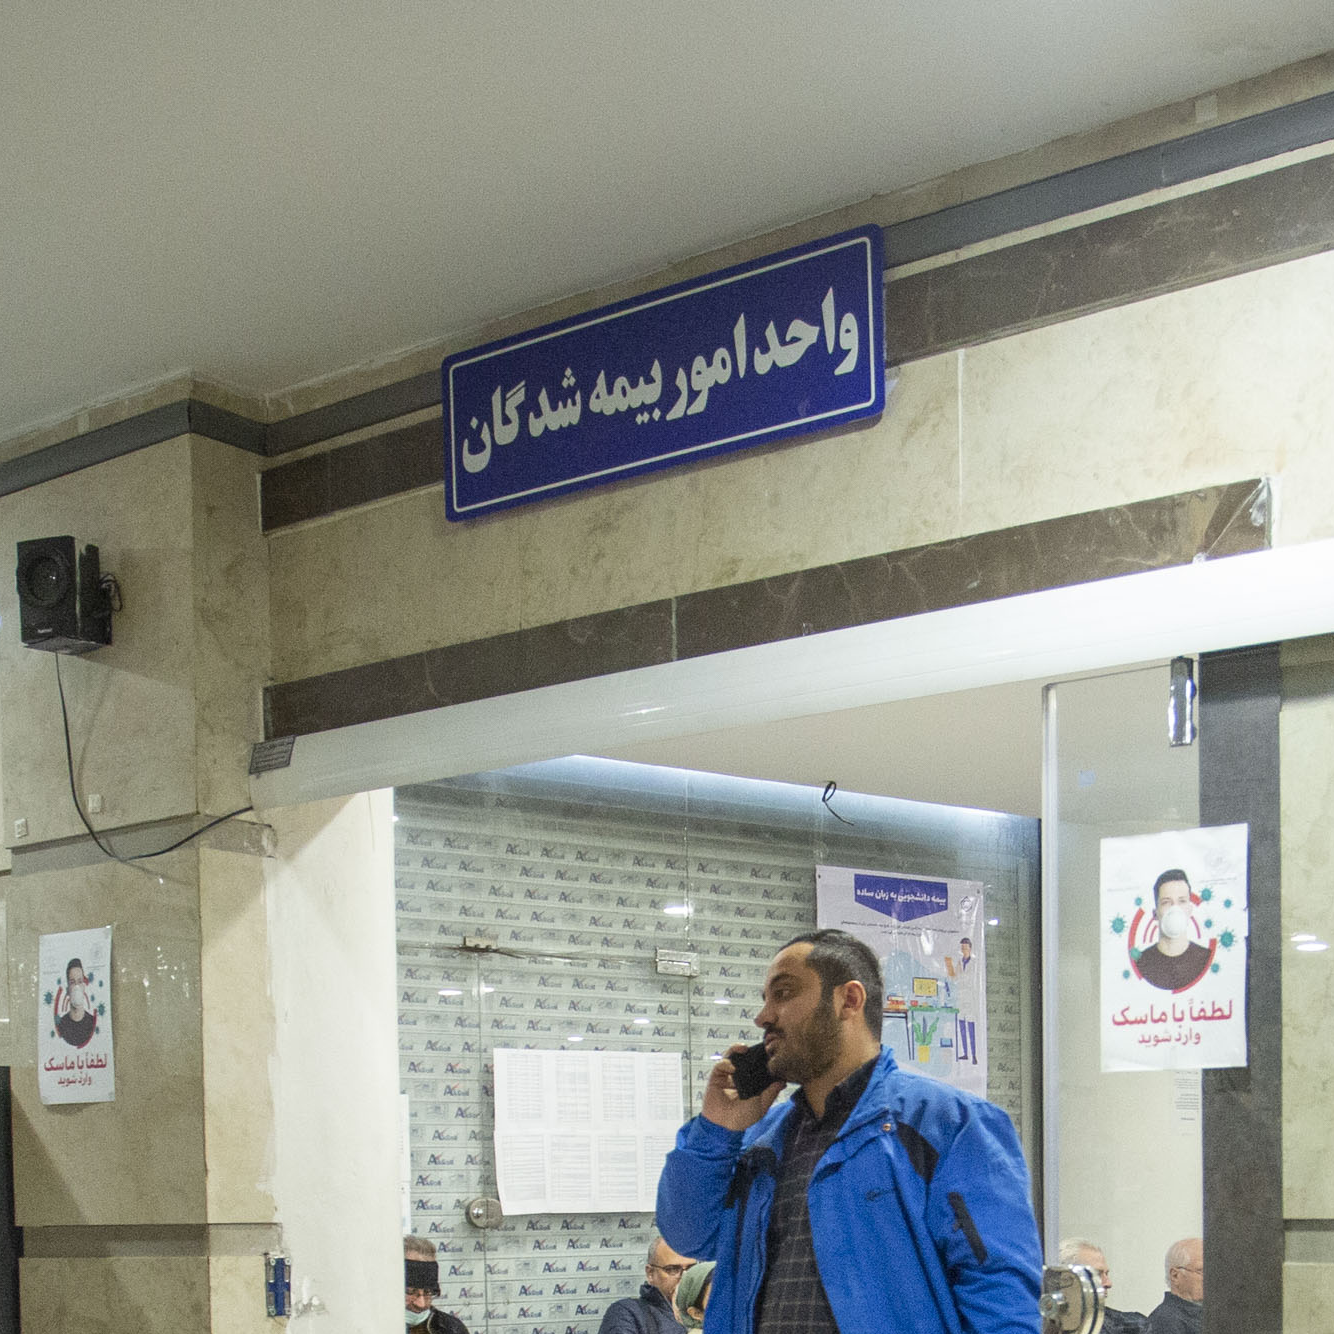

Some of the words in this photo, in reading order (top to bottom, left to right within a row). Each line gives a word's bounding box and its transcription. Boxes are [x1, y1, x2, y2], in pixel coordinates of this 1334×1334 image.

[753, 286, 859, 376] واحد
[666, 313, 747, 421] امور
[589, 358, 663, 426] بیمه
[462, 367, 582, 474] شدگان
[1112, 1004, 1168, 1026] ماسک
[1172, 1002, 1185, 1029] با
[1138, 1029, 1172, 1048] شوید
[1174, 1027, 1201, 1046] وارد
[43, 1055, 76, 1072] ماسک
